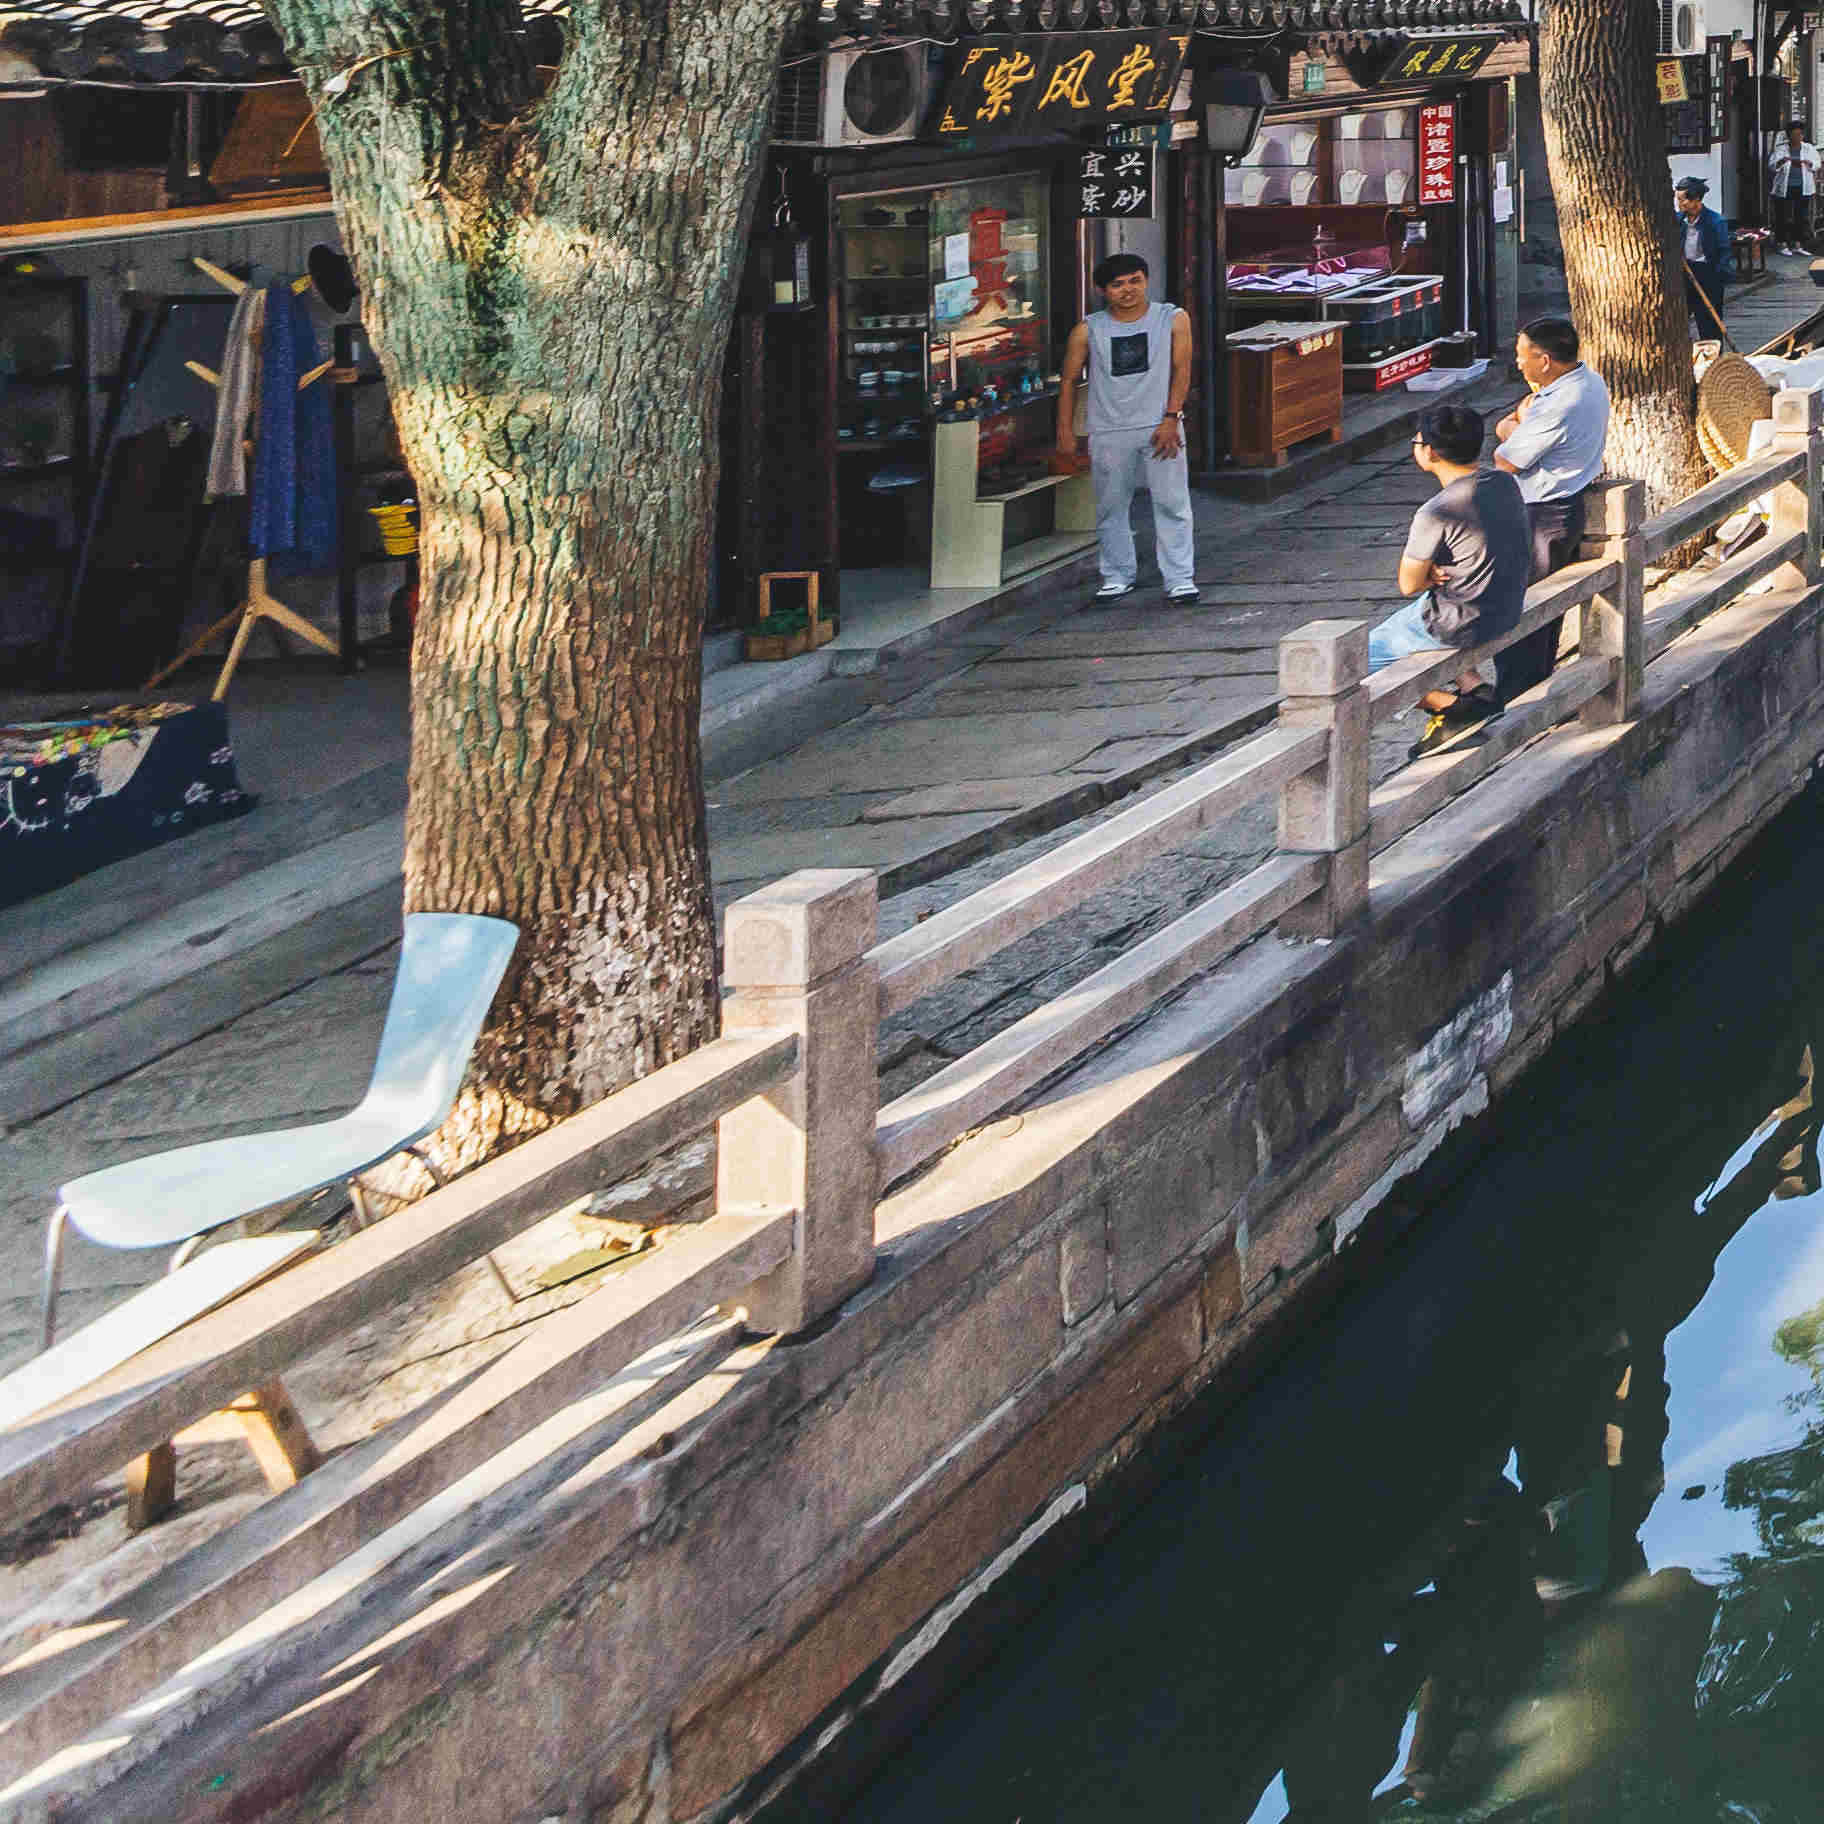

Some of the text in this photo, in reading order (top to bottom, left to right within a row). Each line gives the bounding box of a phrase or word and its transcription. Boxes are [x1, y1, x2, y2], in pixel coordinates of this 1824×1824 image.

[976, 43, 1155, 122] 紫风堂
[1423, 105, 1452, 118] 中国
[1080, 152, 1145, 177] 宜兴
[1424, 122, 1451, 187] 诸暨珍珠
